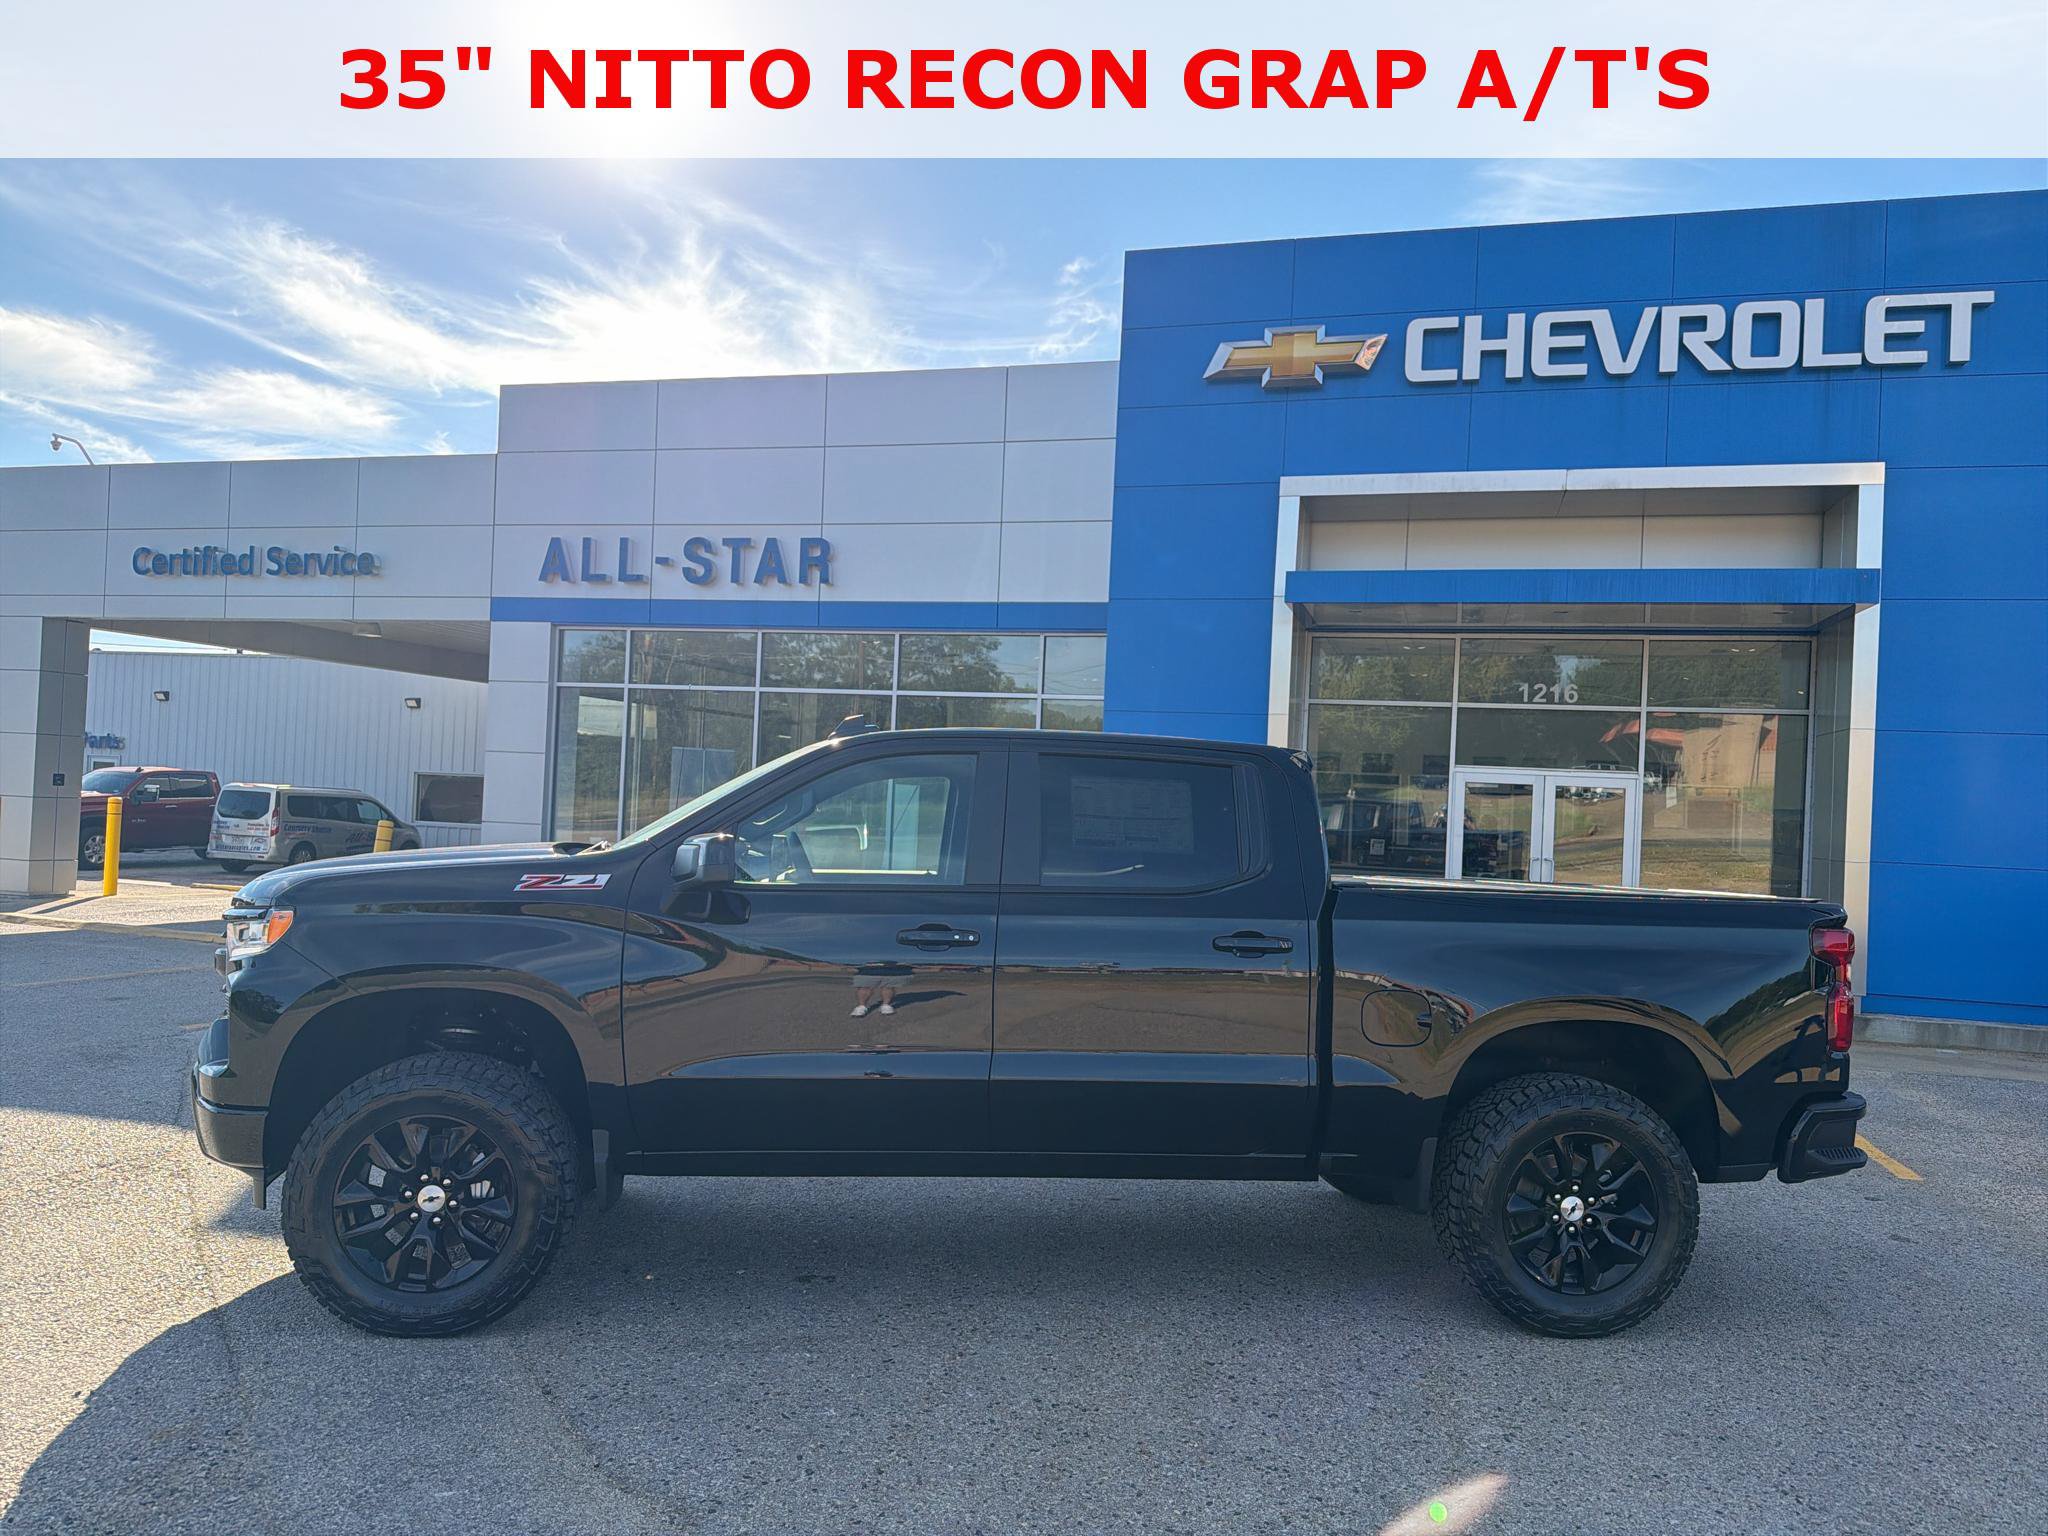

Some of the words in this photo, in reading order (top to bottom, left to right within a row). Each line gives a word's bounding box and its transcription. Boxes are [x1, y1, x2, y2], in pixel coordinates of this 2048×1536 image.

[1402, 289, 1997, 384] CHEVROLET
[132, 545, 256, 577] Certified
[265, 545, 377, 577] Service
[538, 536, 833, 586] ALL-STAR
[1518, 682, 1580, 704] 1216
[513, 873, 612, 892] Z71
